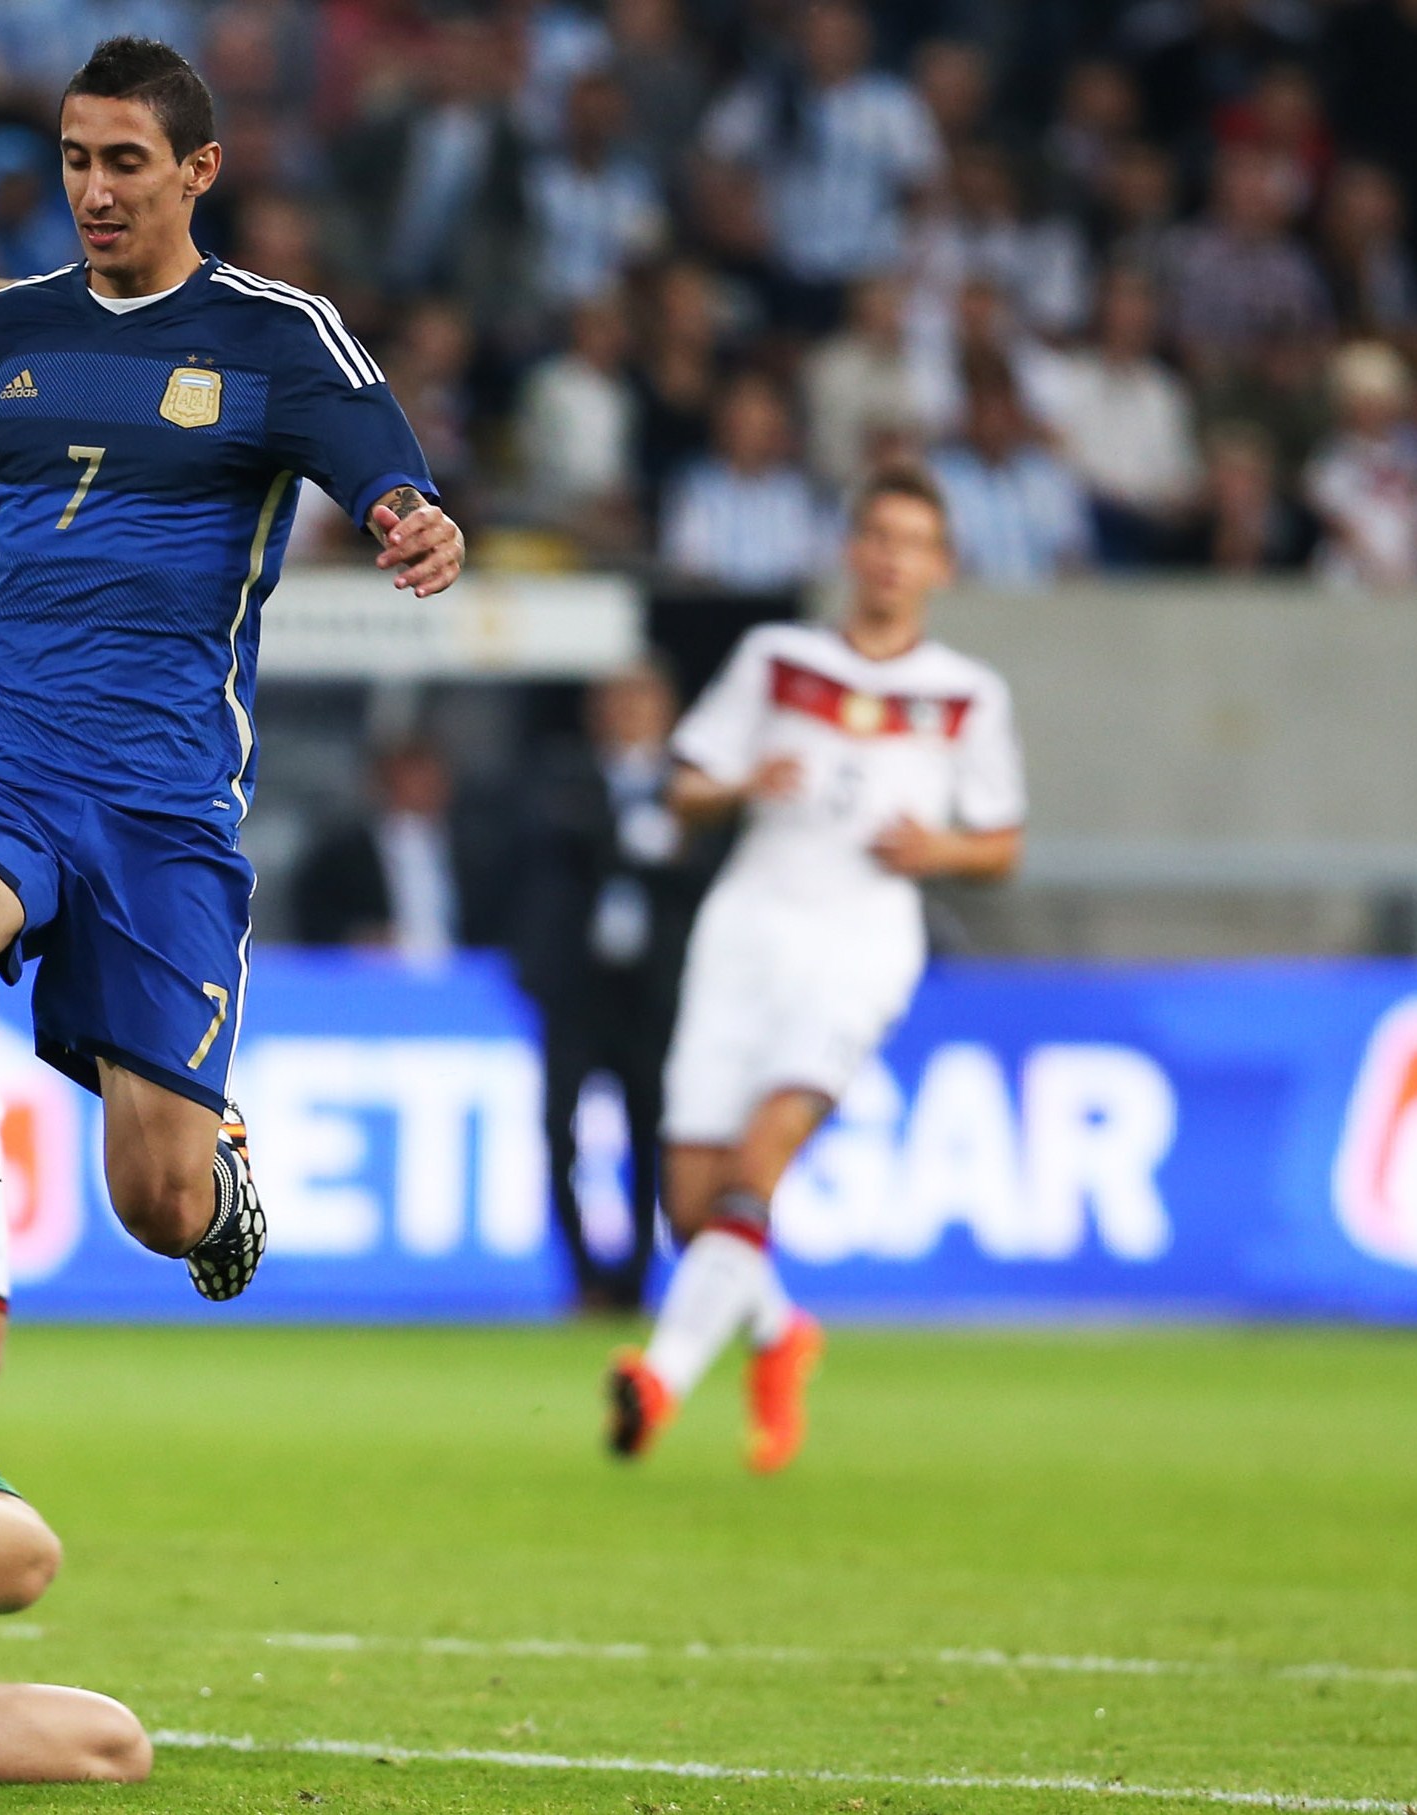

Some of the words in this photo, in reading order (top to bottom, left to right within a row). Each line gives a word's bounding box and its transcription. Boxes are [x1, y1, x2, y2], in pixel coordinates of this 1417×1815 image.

[0, 387, 38, 400] adidas
[55, 445, 106, 530] 7
[187, 981, 229, 1071] 7
